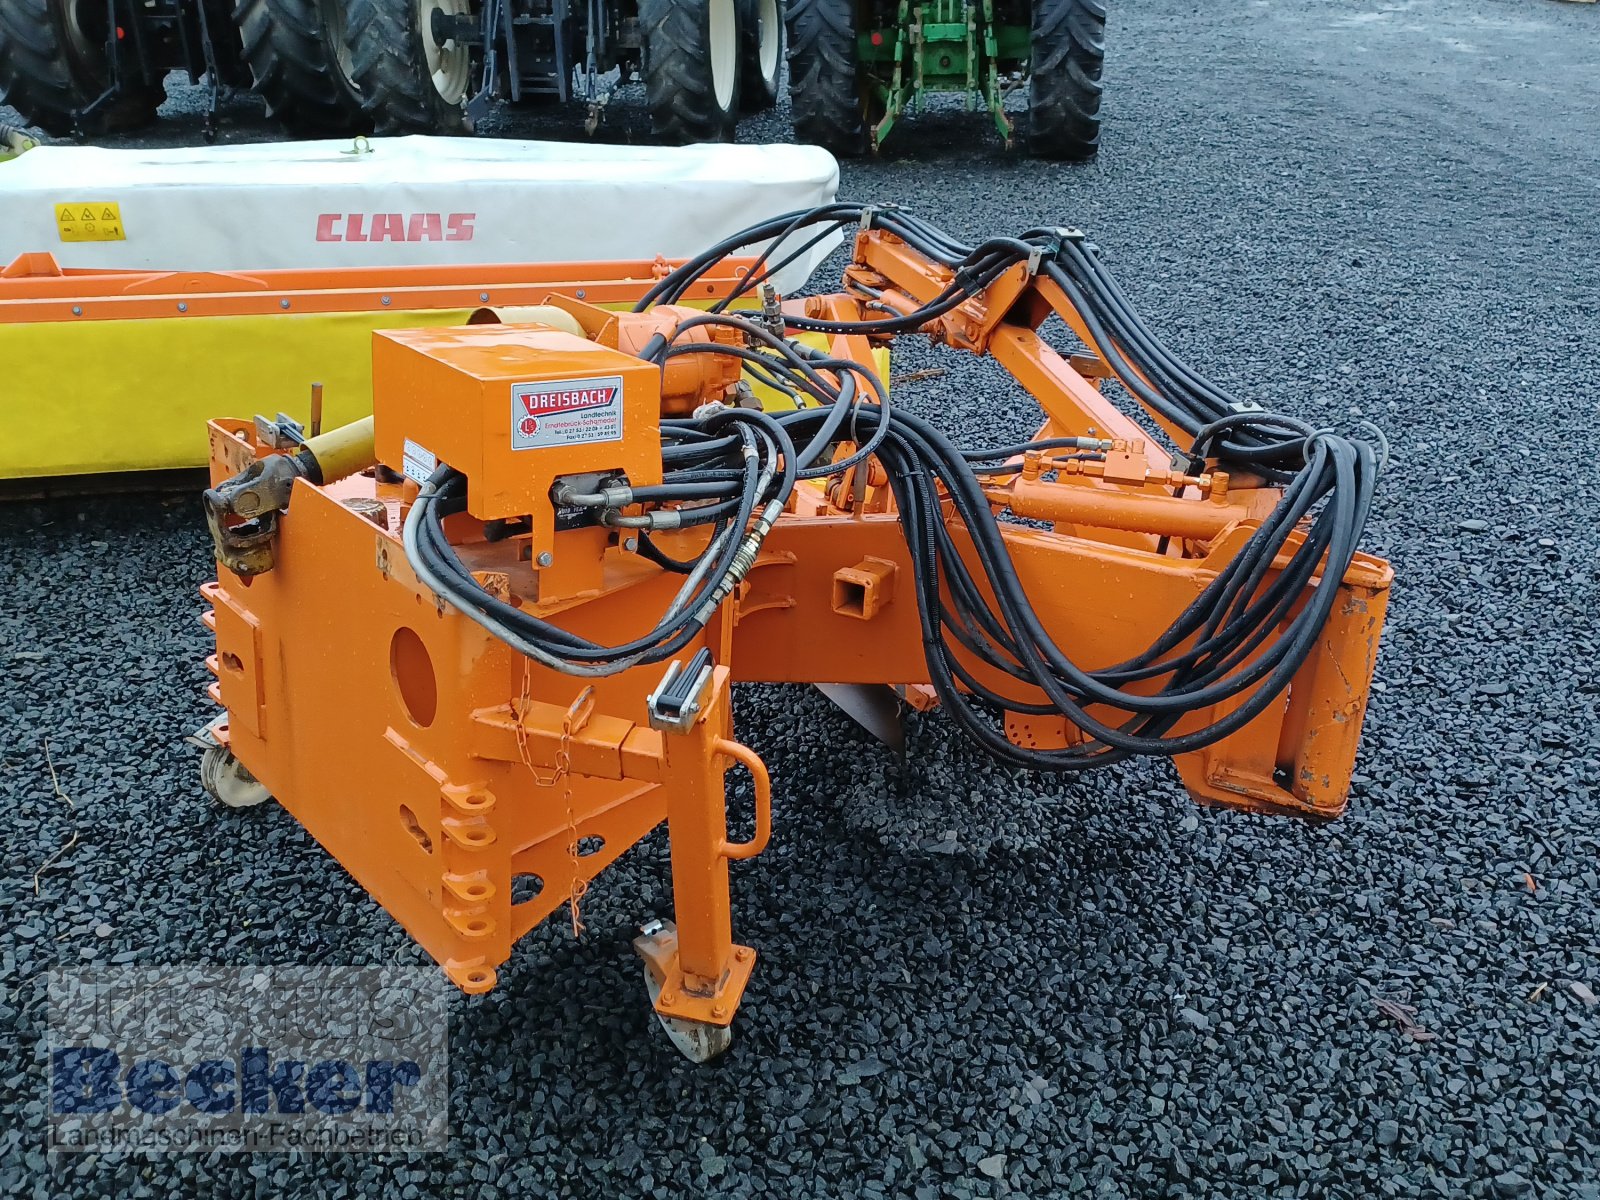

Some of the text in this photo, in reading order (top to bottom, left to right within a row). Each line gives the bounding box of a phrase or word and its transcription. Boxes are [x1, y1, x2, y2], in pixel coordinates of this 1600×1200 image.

[316, 213, 476, 242] CLAAS
[529, 390, 606, 409] DREISBACH
[581, 410, 616, 418] Landtechnik
